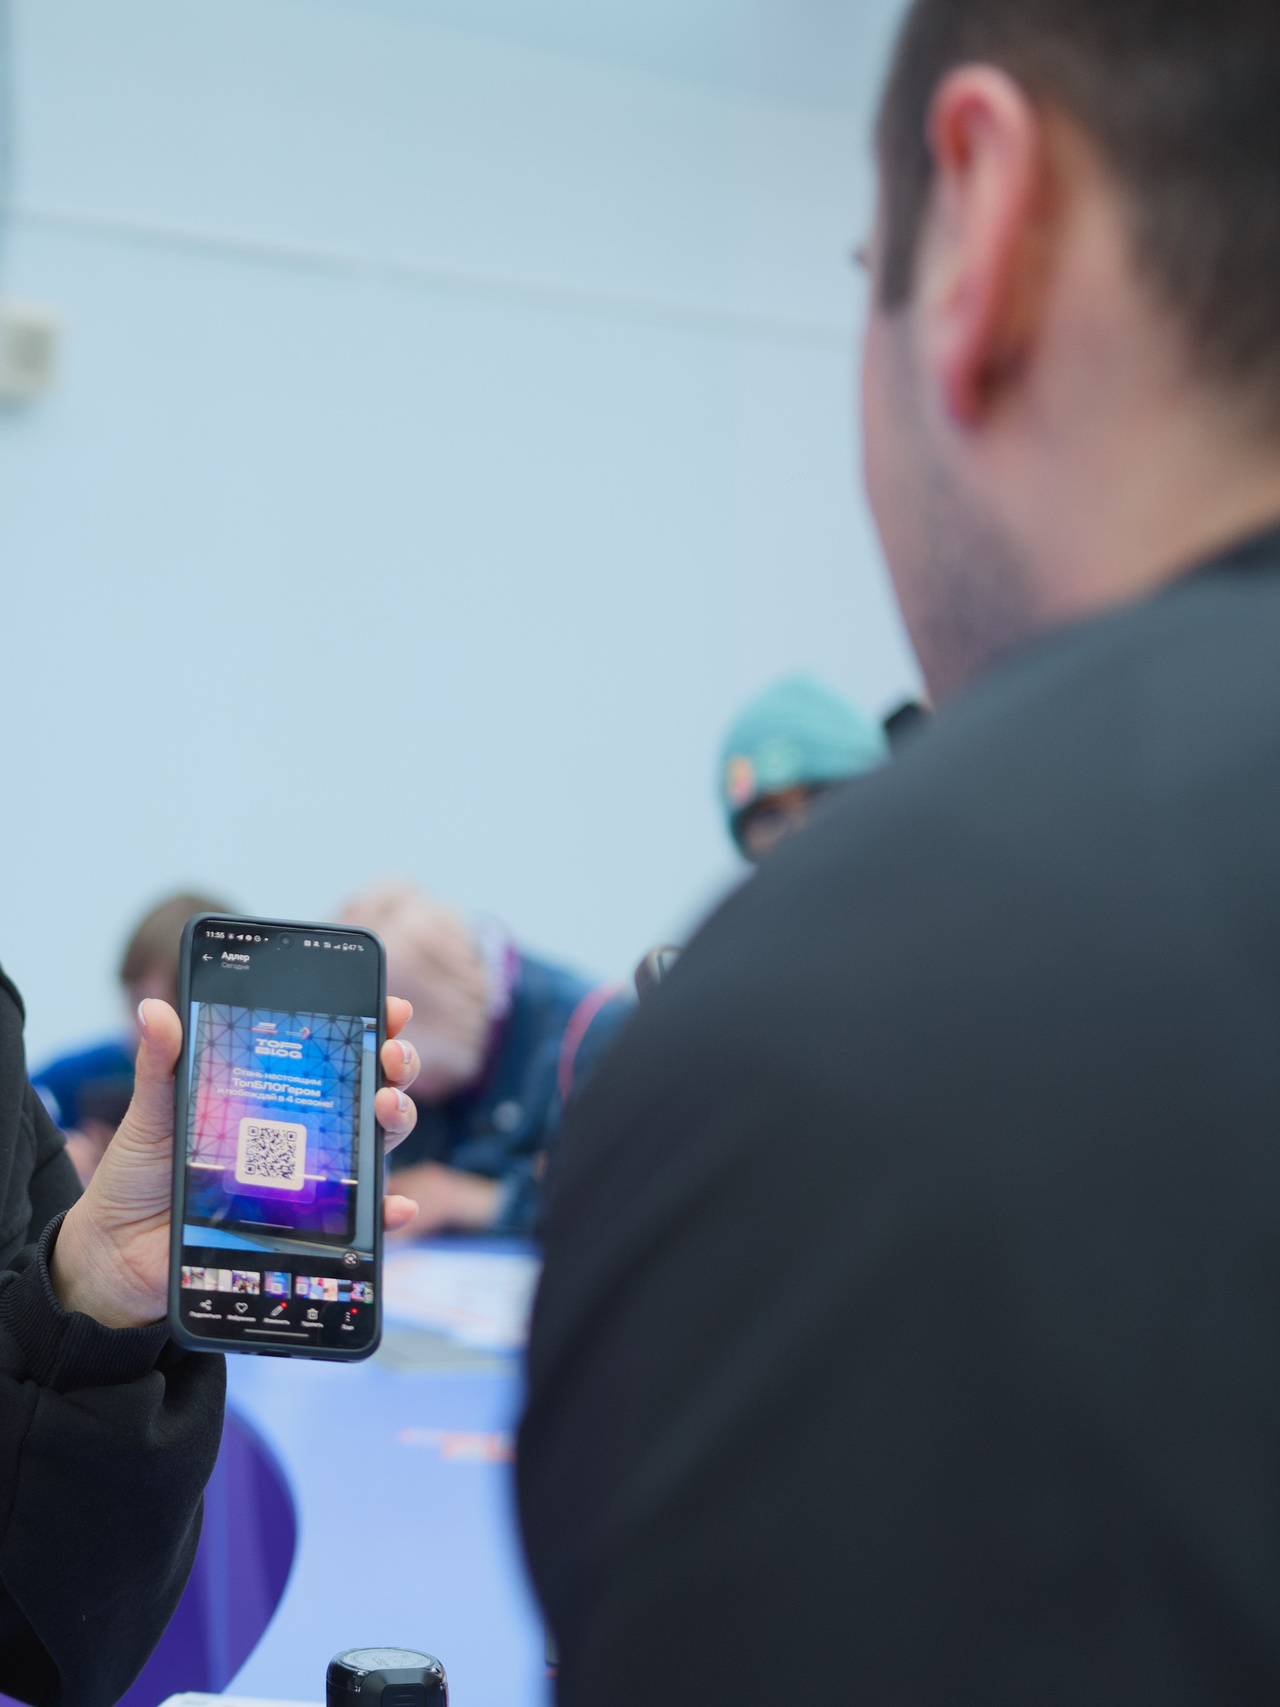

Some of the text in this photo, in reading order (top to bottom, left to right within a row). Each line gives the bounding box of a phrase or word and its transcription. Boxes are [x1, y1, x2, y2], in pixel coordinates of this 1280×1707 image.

[206, 930, 225, 939] 11:55
[221, 951, 250, 963] Адлер
[221, 962, 250, 971] Сегодня
[232, 1067, 322, 1086] Стань настоящим
[232, 1077, 321, 1097] ТопБЛОГером
[217, 1087, 225, 1095] и
[225, 1087, 277, 1102] побеждай
[285, 1095, 294, 1103] 4
[295, 1097, 335, 1109] сезоне!
